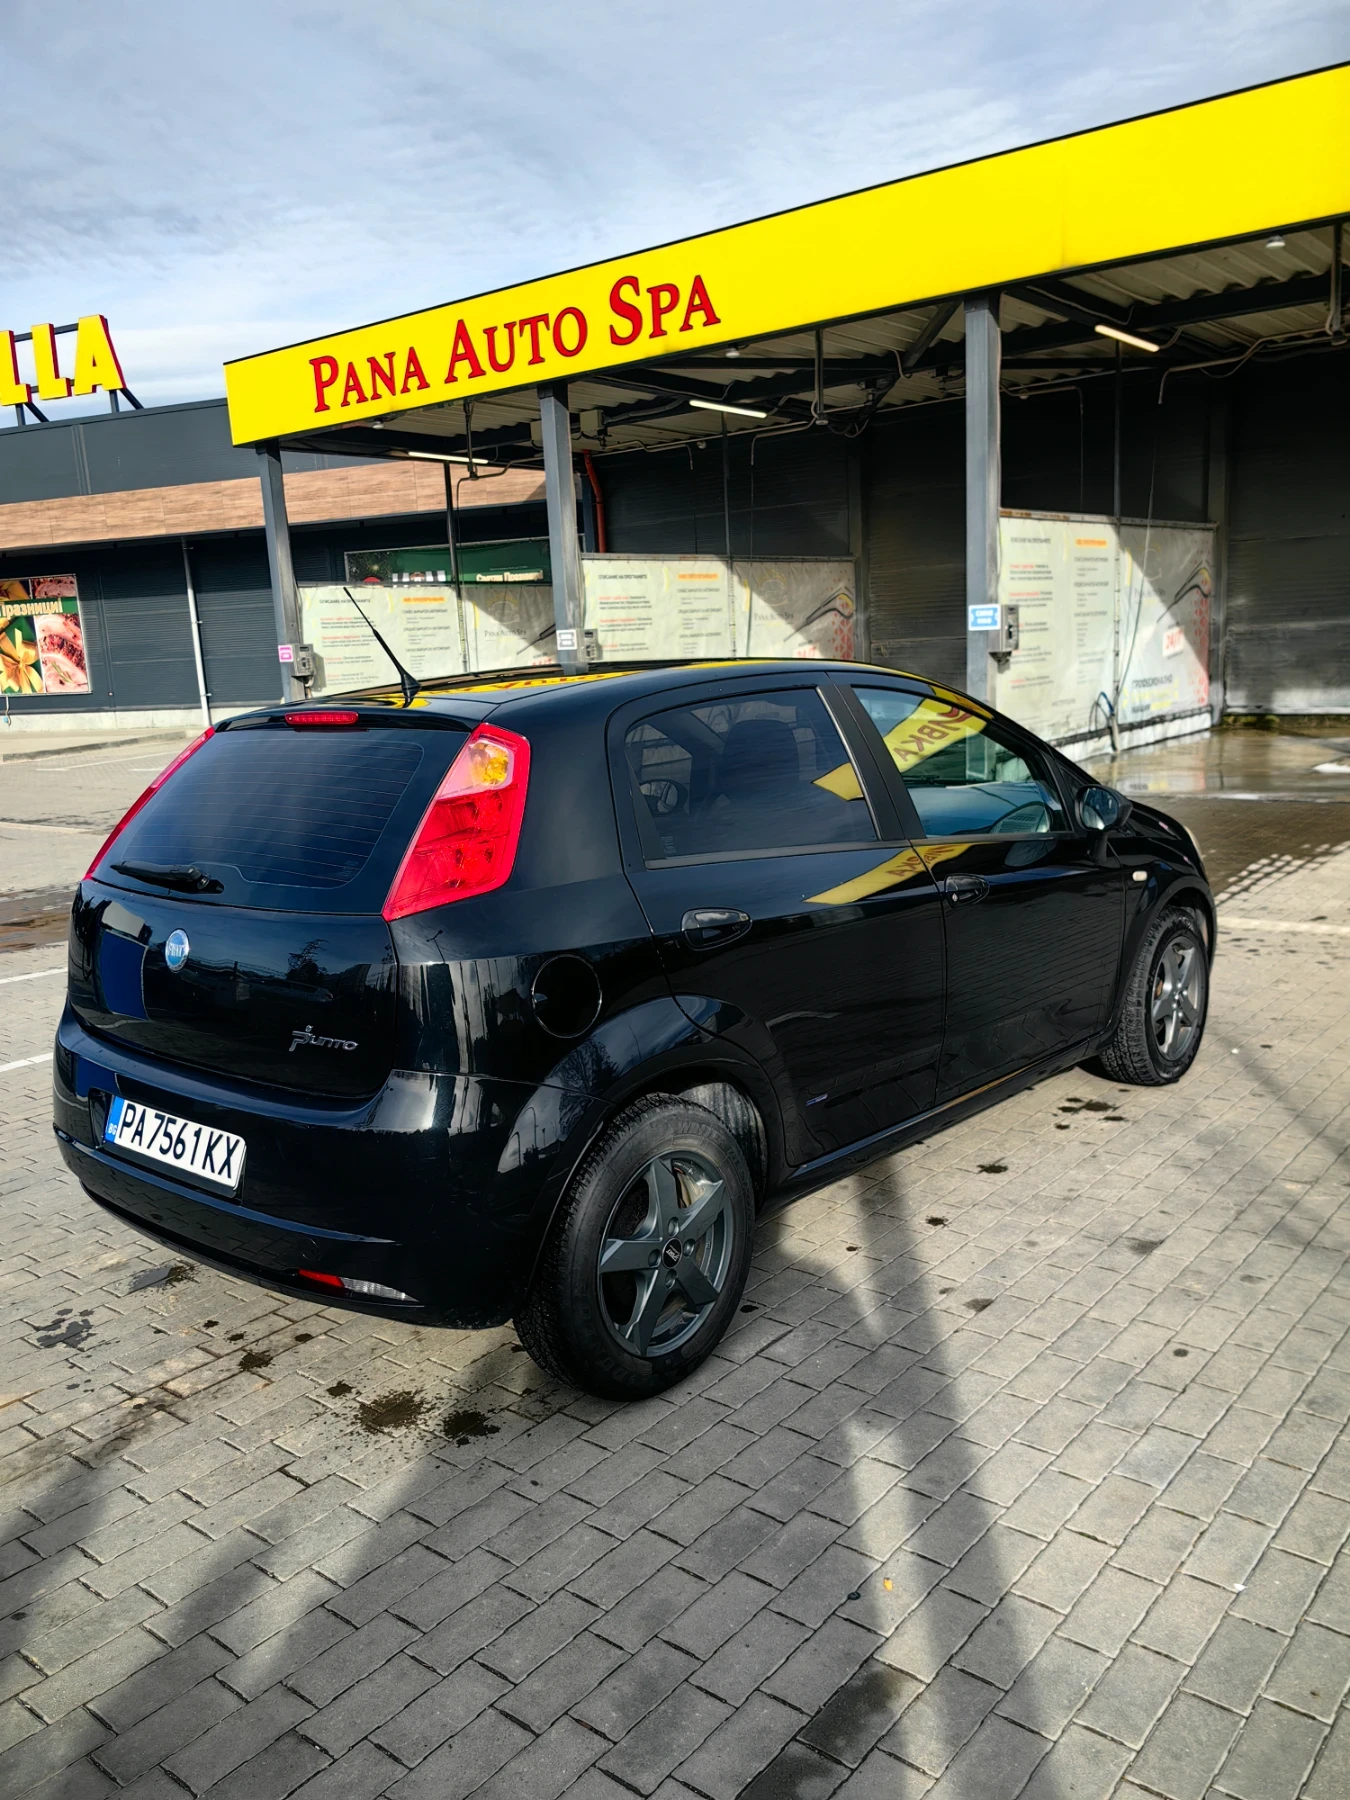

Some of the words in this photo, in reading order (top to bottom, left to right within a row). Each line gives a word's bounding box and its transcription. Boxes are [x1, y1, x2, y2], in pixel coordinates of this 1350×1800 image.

[309, 346, 430, 413] PANA
[444, 306, 589, 384] AUTO
[609, 274, 722, 346] SPA
[108, 1122, 118, 1136] BG
